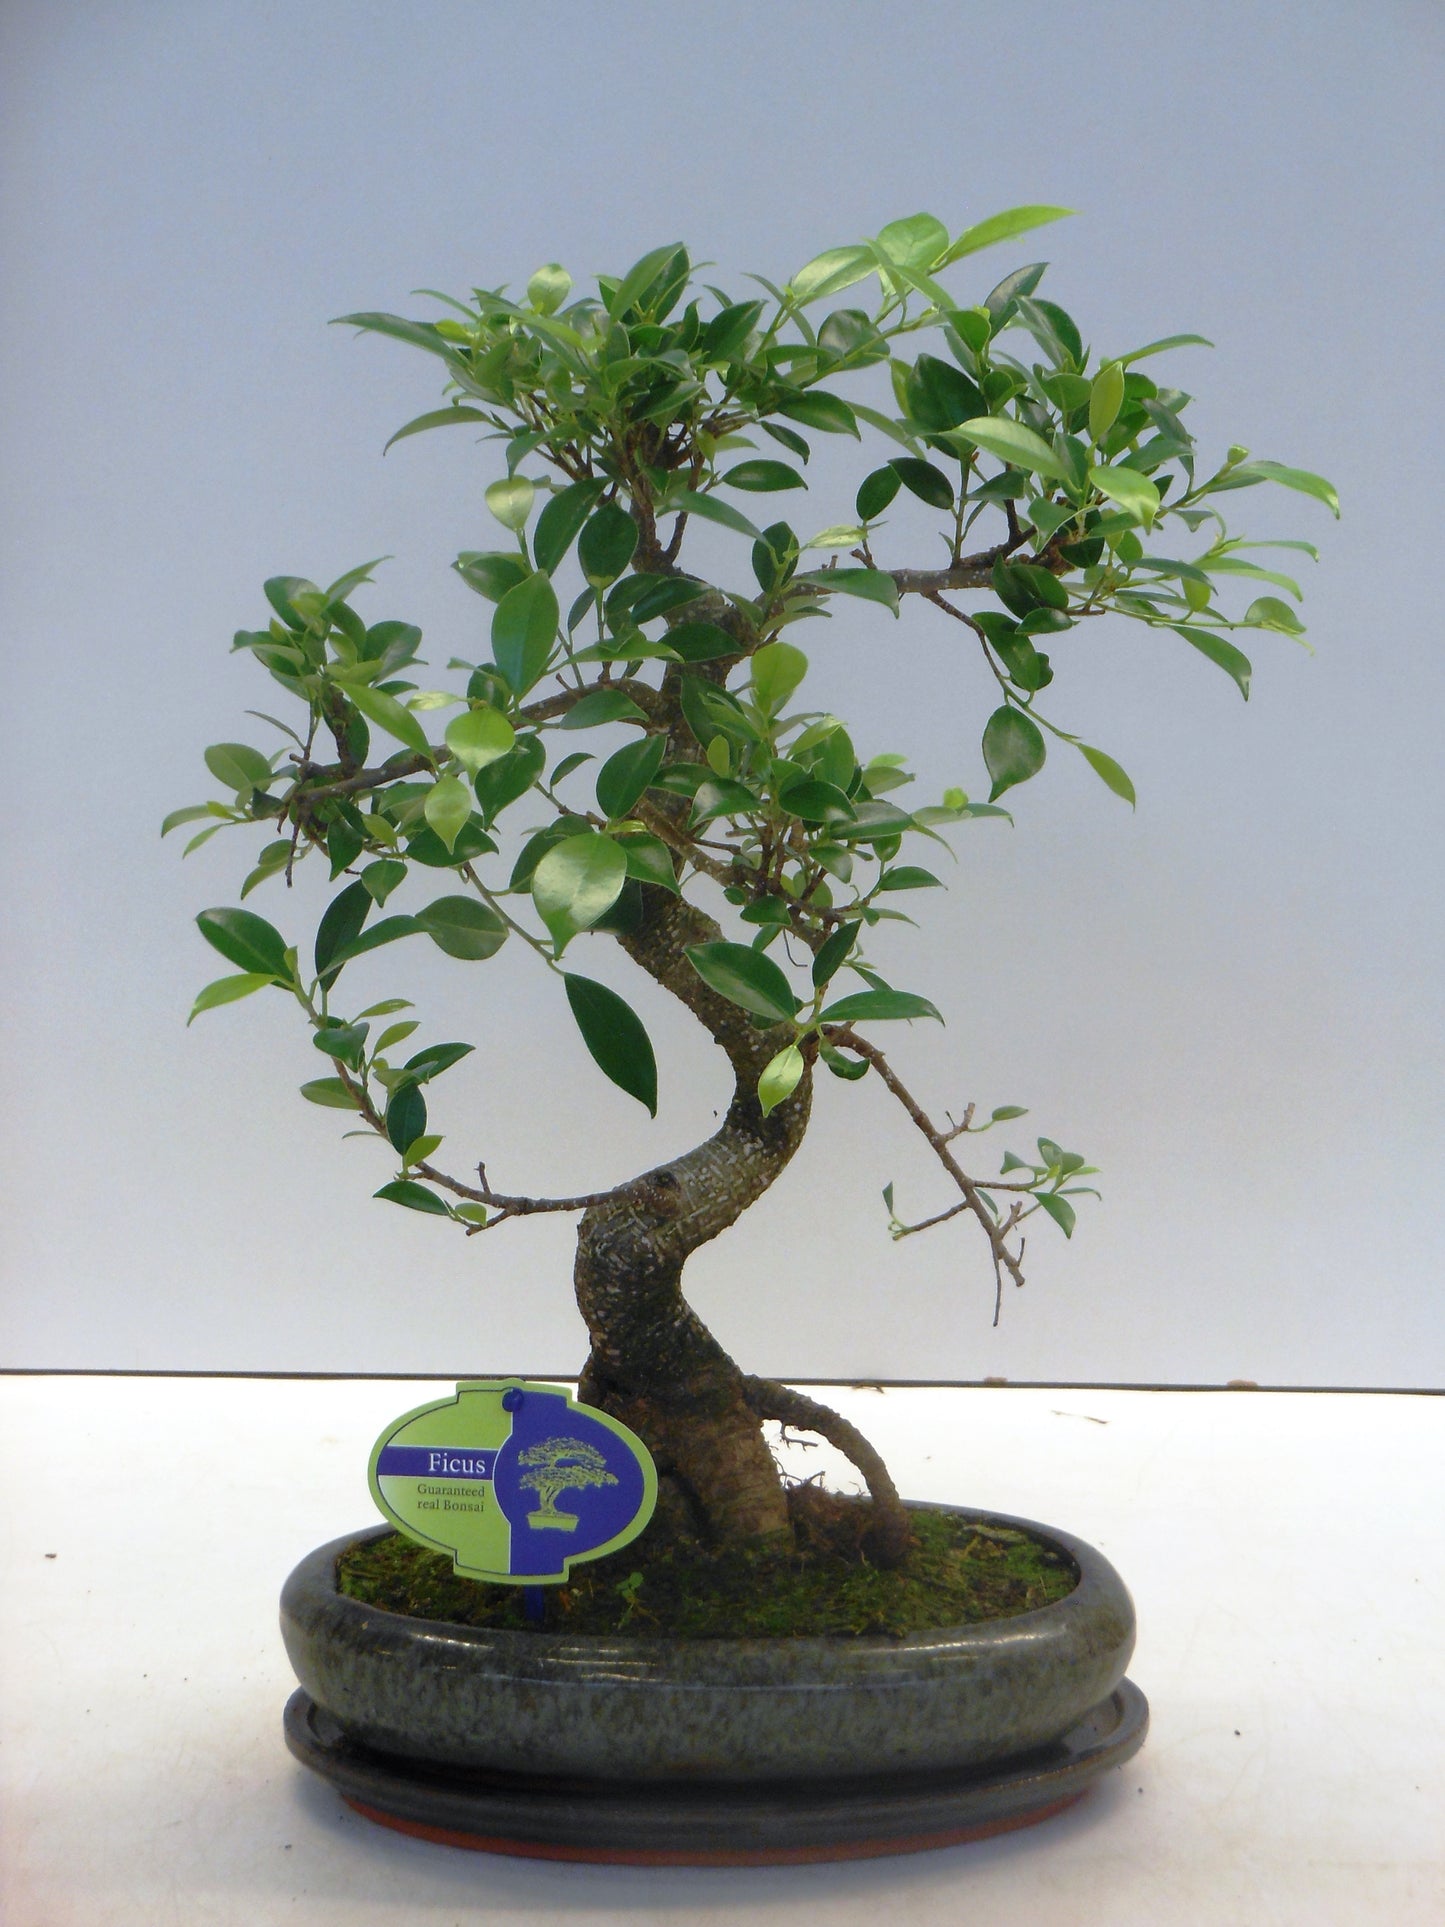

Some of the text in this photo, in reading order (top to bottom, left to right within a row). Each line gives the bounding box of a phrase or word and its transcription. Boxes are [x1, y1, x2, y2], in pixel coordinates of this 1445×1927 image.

[428, 1452, 486, 1474] Ficus
[417, 1483, 485, 1498] Guaranteed
[417, 1499, 485, 1512] real Bonsai
